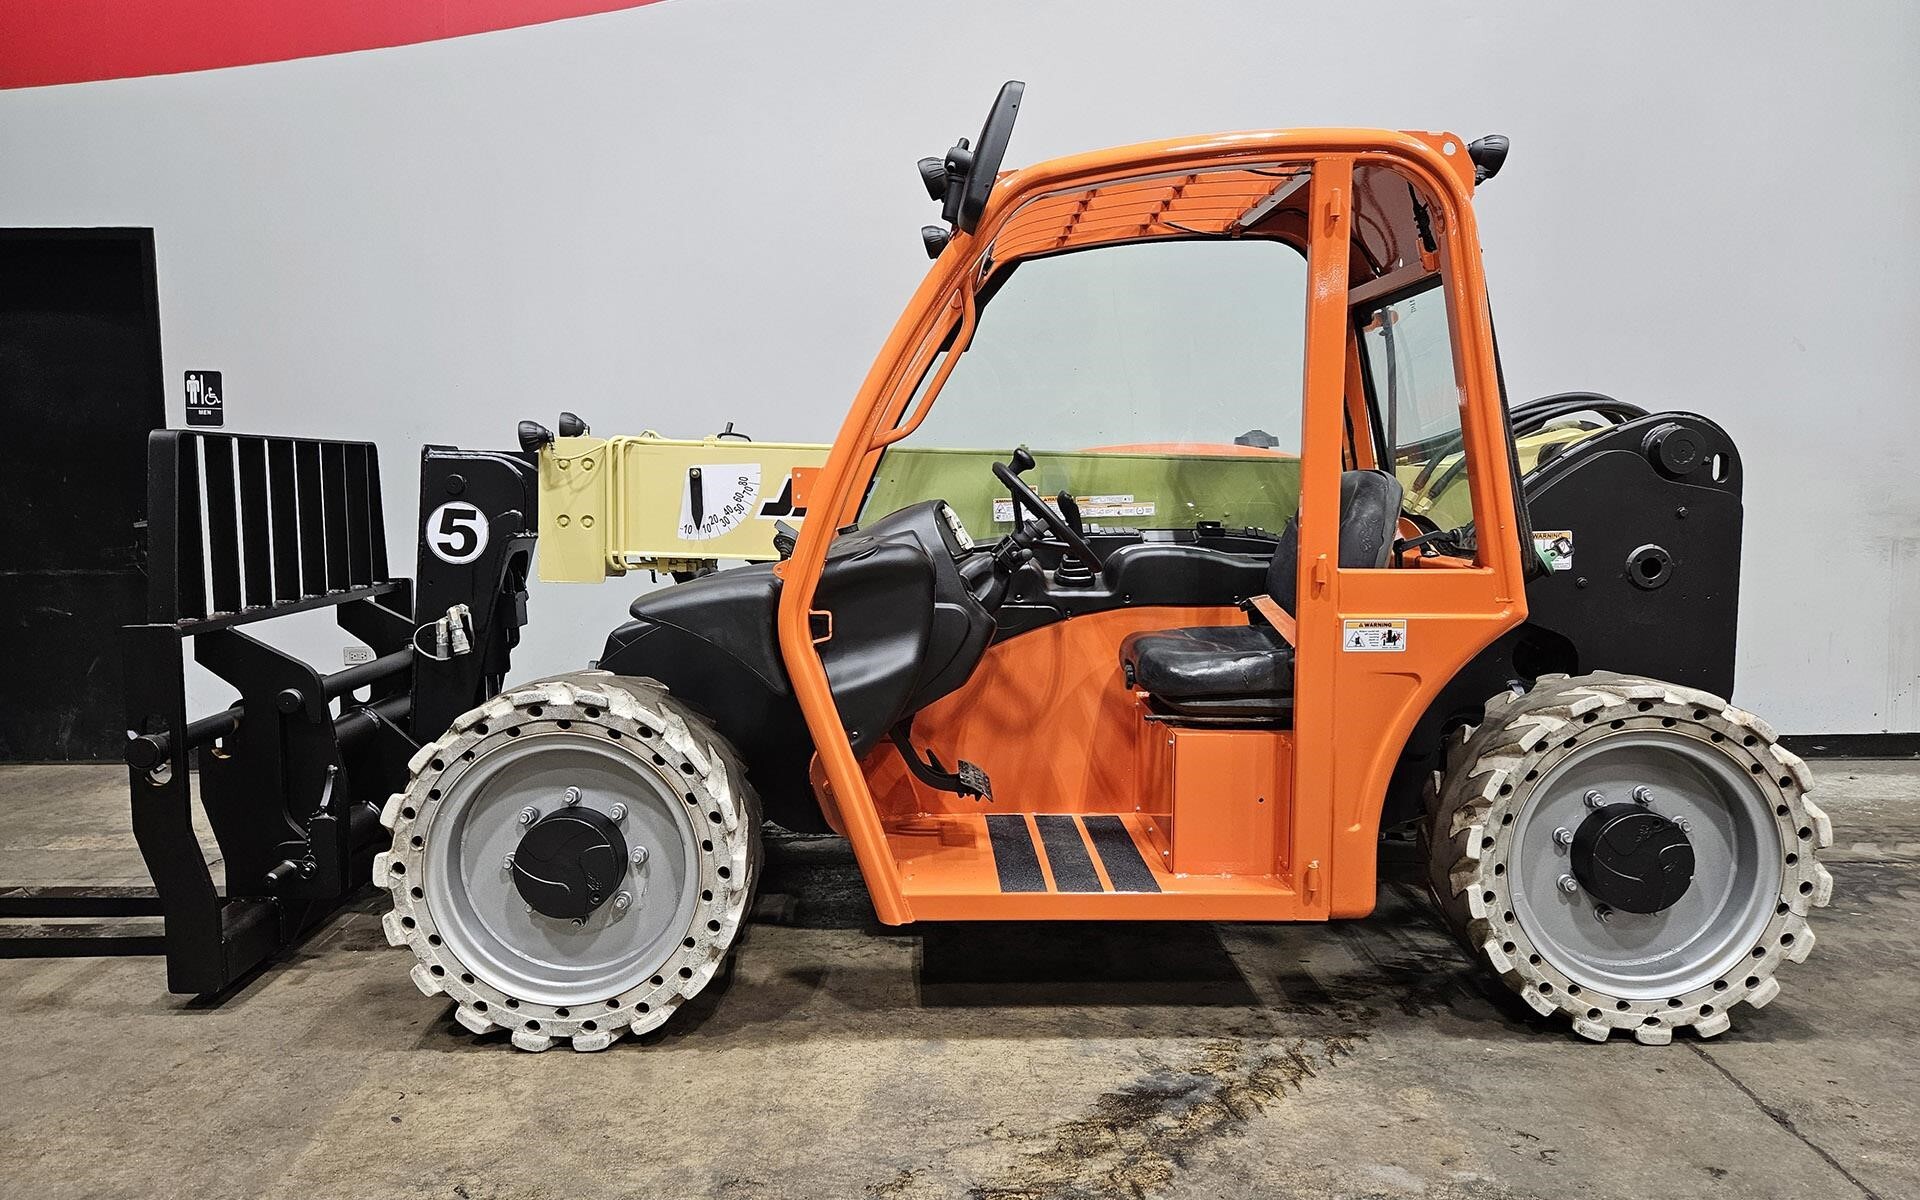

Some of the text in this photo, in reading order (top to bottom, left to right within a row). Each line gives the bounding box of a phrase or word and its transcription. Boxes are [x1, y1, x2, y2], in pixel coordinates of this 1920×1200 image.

[738, 476, 748, 486] 80
[742, 486, 753, 496] 70
[733, 492, 744, 503] 60
[723, 505, 734, 516] 40
[734, 503, 745, 514] 50
[708, 514, 719, 525] 20
[719, 516, 730, 527] 30
[437, 508, 478, 557] 5
[702, 523, 711, 533] 10
